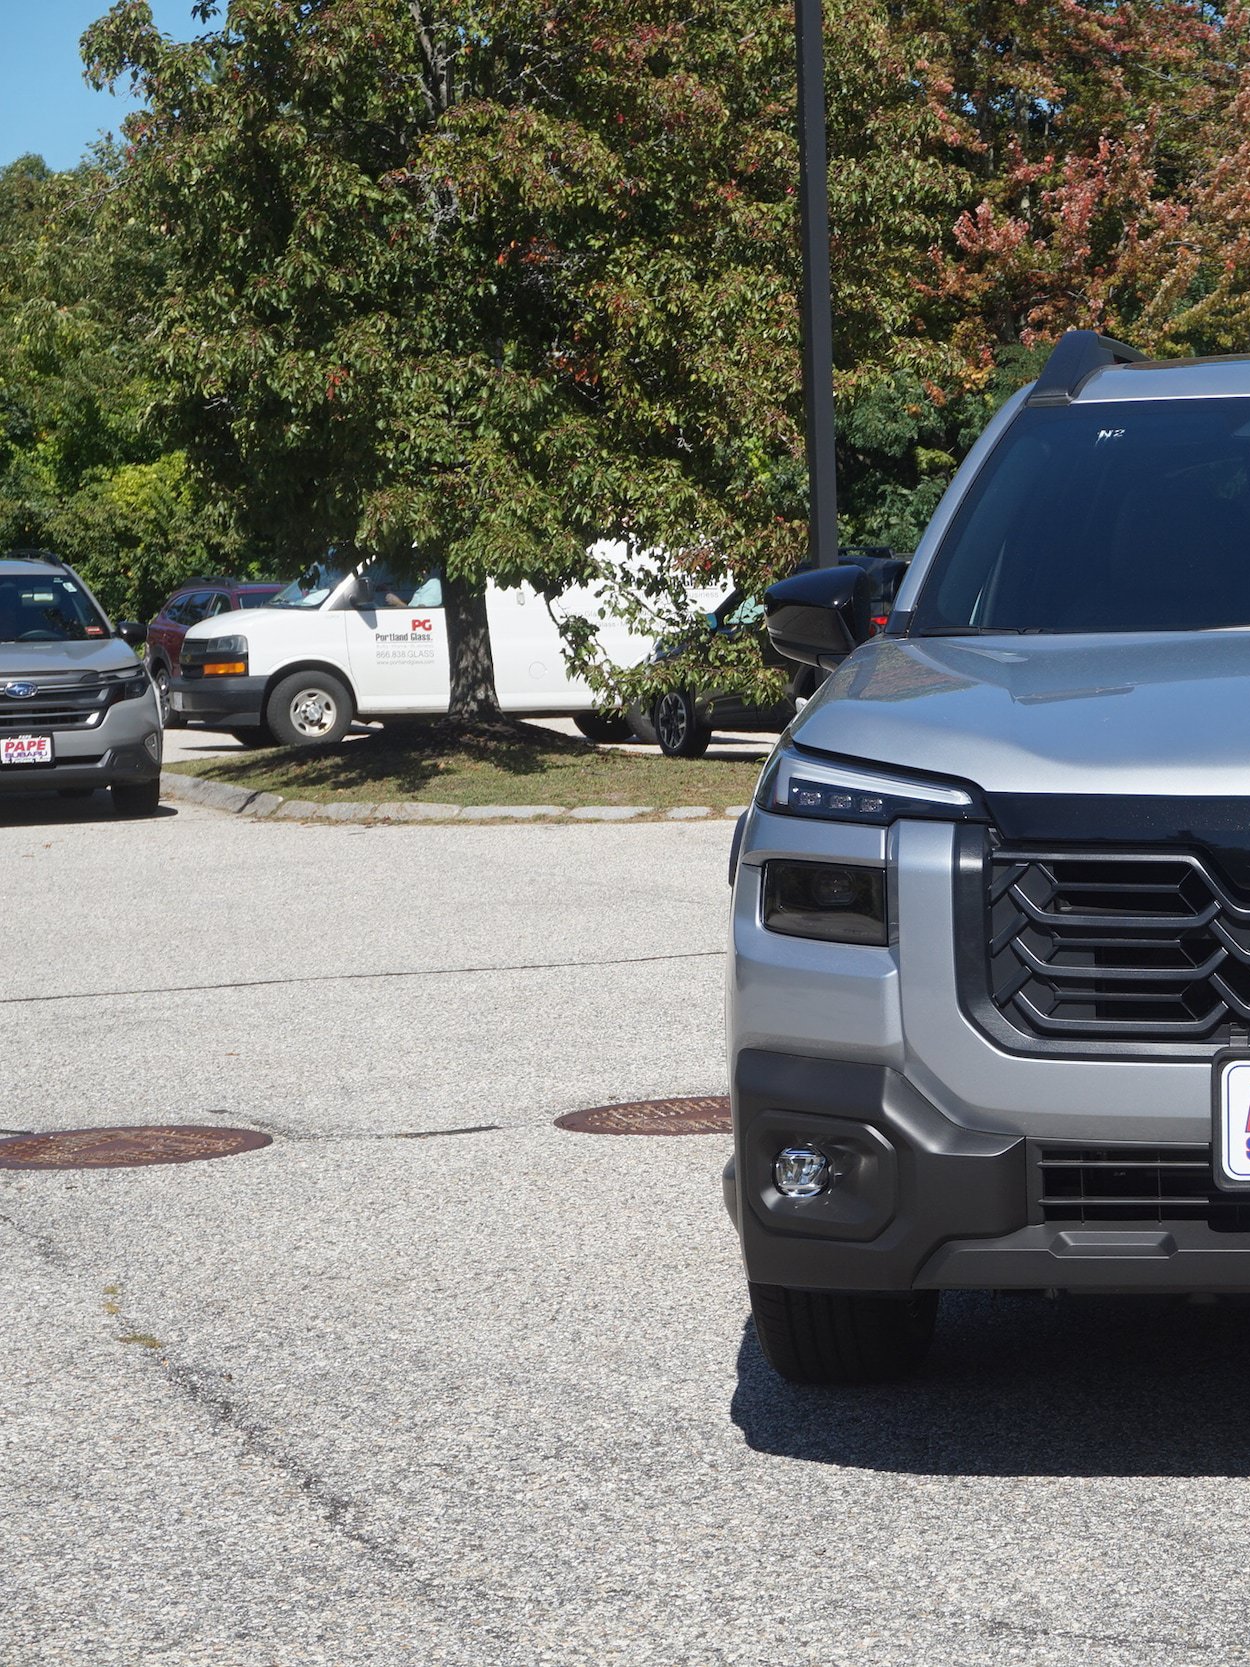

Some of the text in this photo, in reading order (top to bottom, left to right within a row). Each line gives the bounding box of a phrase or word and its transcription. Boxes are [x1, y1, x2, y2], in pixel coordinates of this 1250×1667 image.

[411, 619, 432, 631] PG
[375, 633, 408, 641] Portland
[5, 740, 46, 752] PAPE
